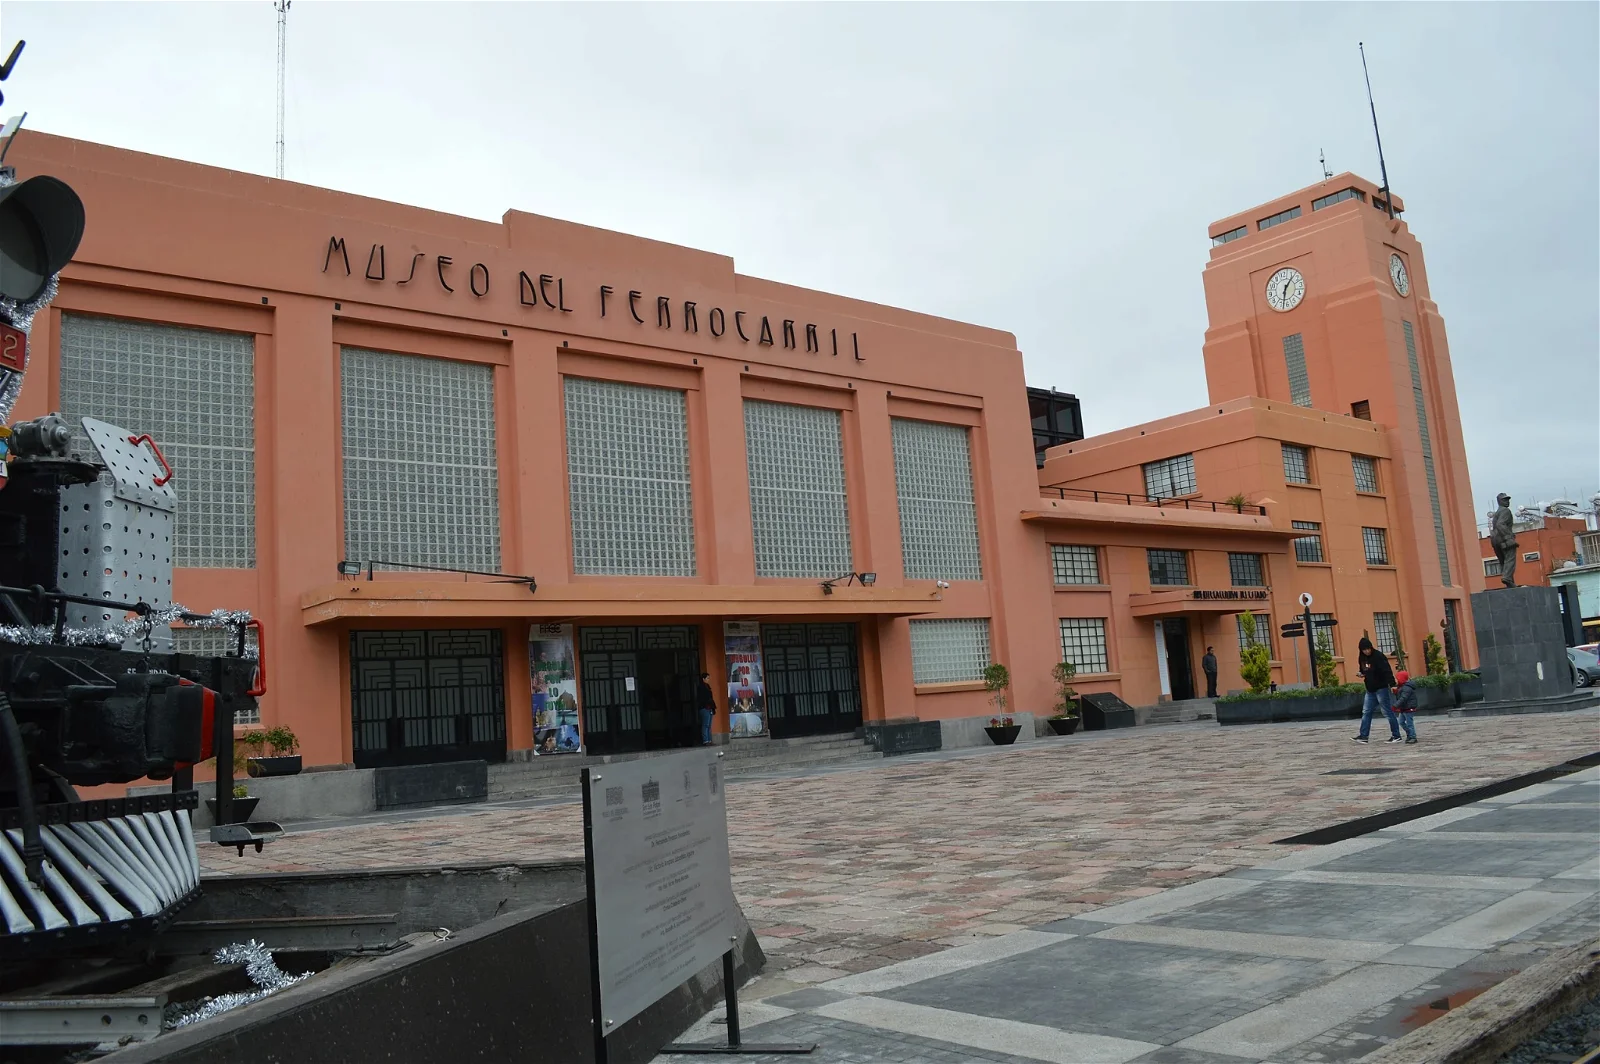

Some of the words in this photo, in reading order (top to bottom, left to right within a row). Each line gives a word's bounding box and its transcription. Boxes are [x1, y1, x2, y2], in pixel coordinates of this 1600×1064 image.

[322, 236, 490, 298] MUSEO
[519, 271, 573, 313] DEL
[599, 285, 866, 362] FERROCARRIL
[548, 687, 559, 698] LO
